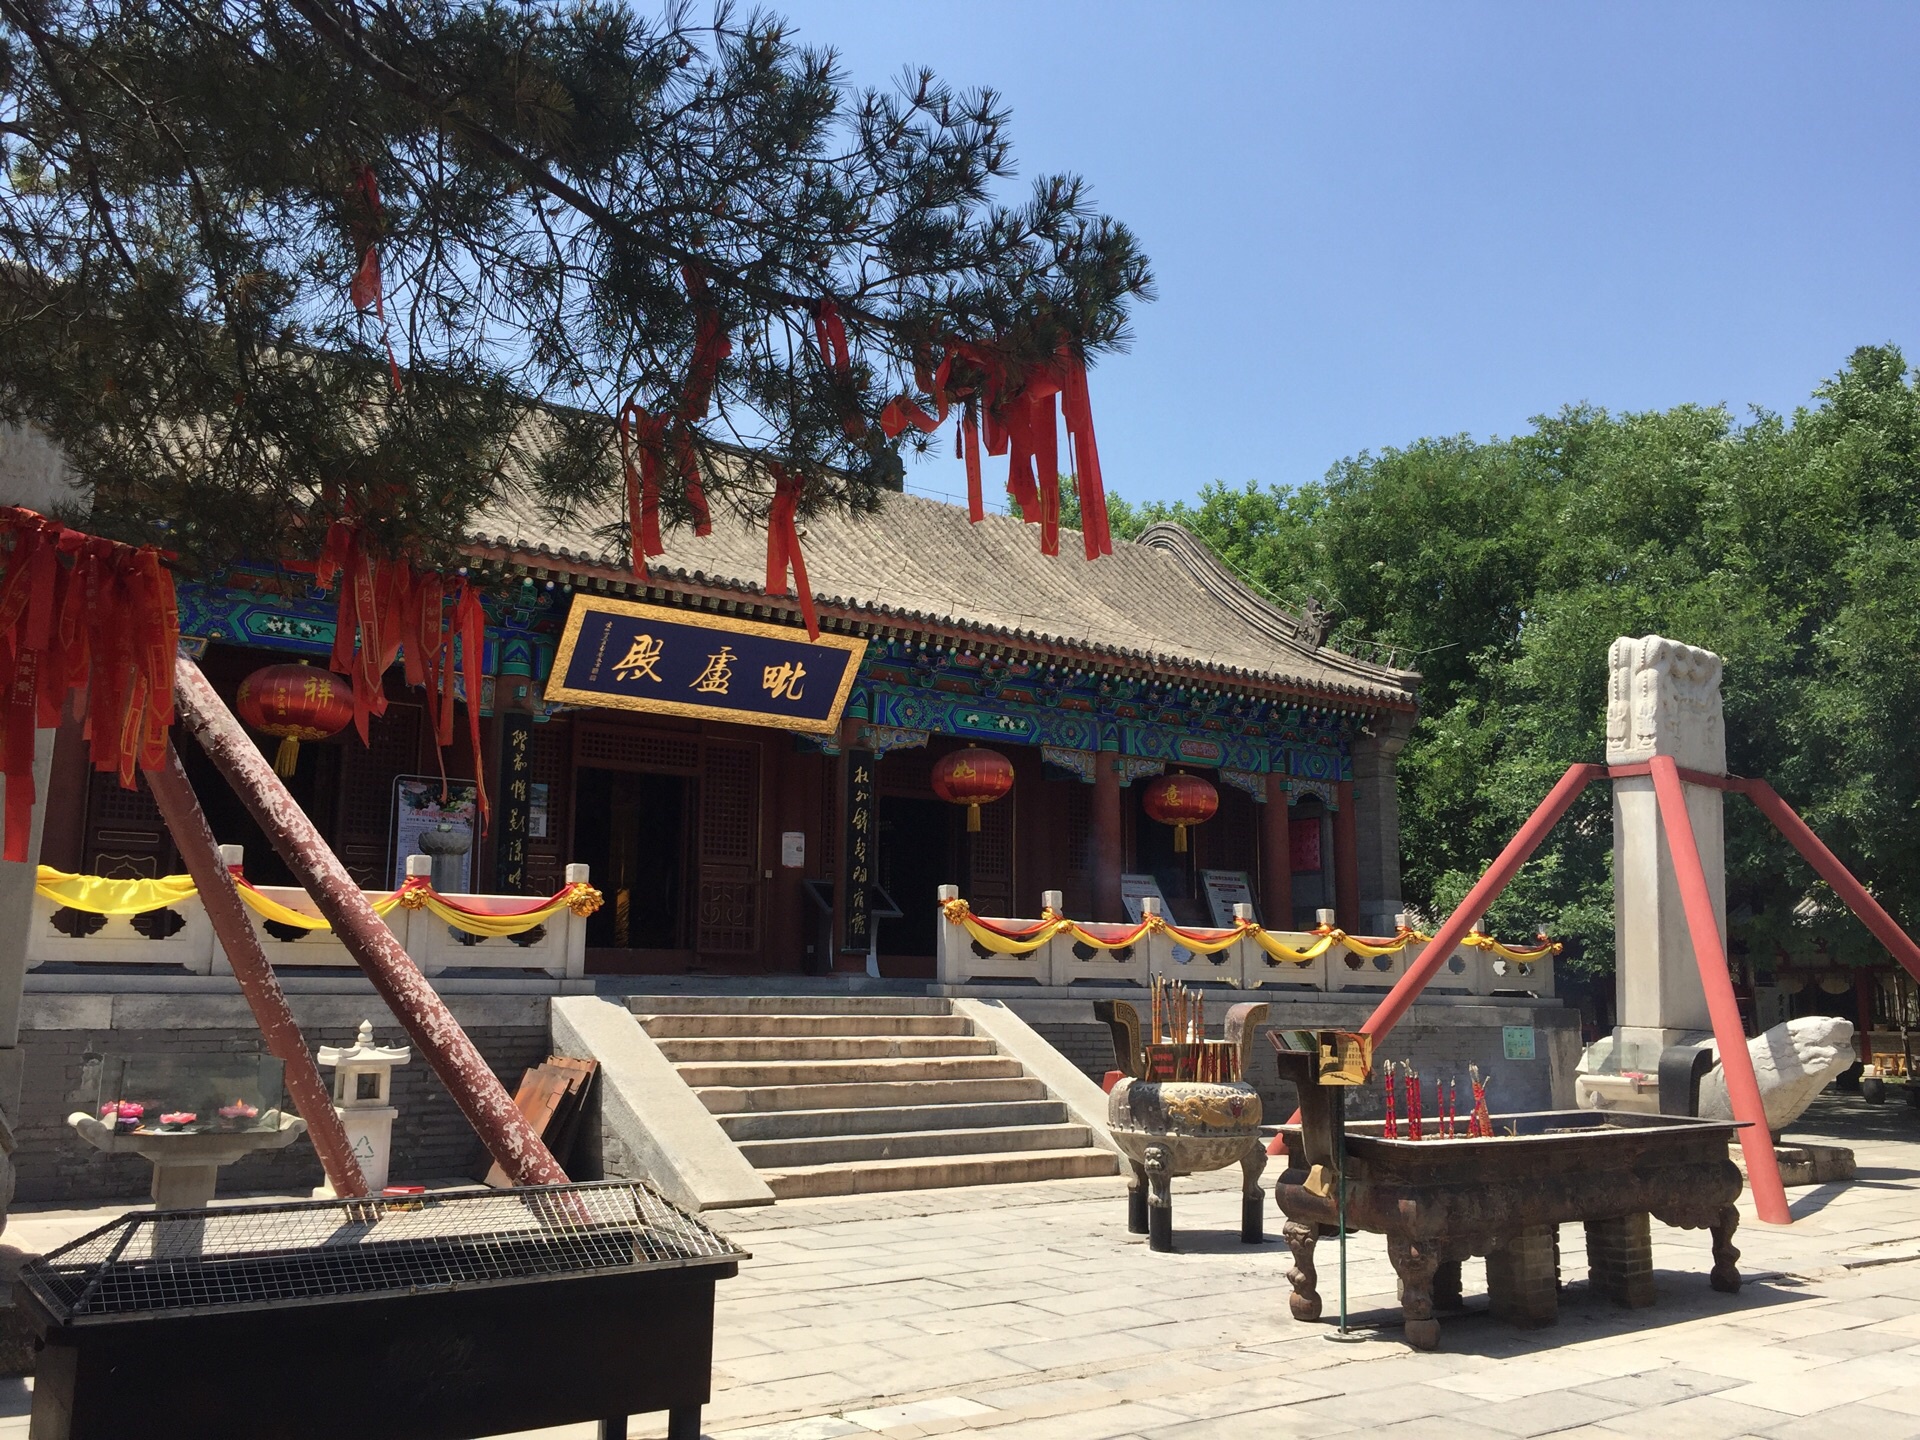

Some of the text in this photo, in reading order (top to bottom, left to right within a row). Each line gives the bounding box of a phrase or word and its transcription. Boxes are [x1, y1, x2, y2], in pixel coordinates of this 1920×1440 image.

[303, 675, 335, 708] 祥
[952, 759, 977, 779] 如
[1161, 783, 1183, 807] 意
